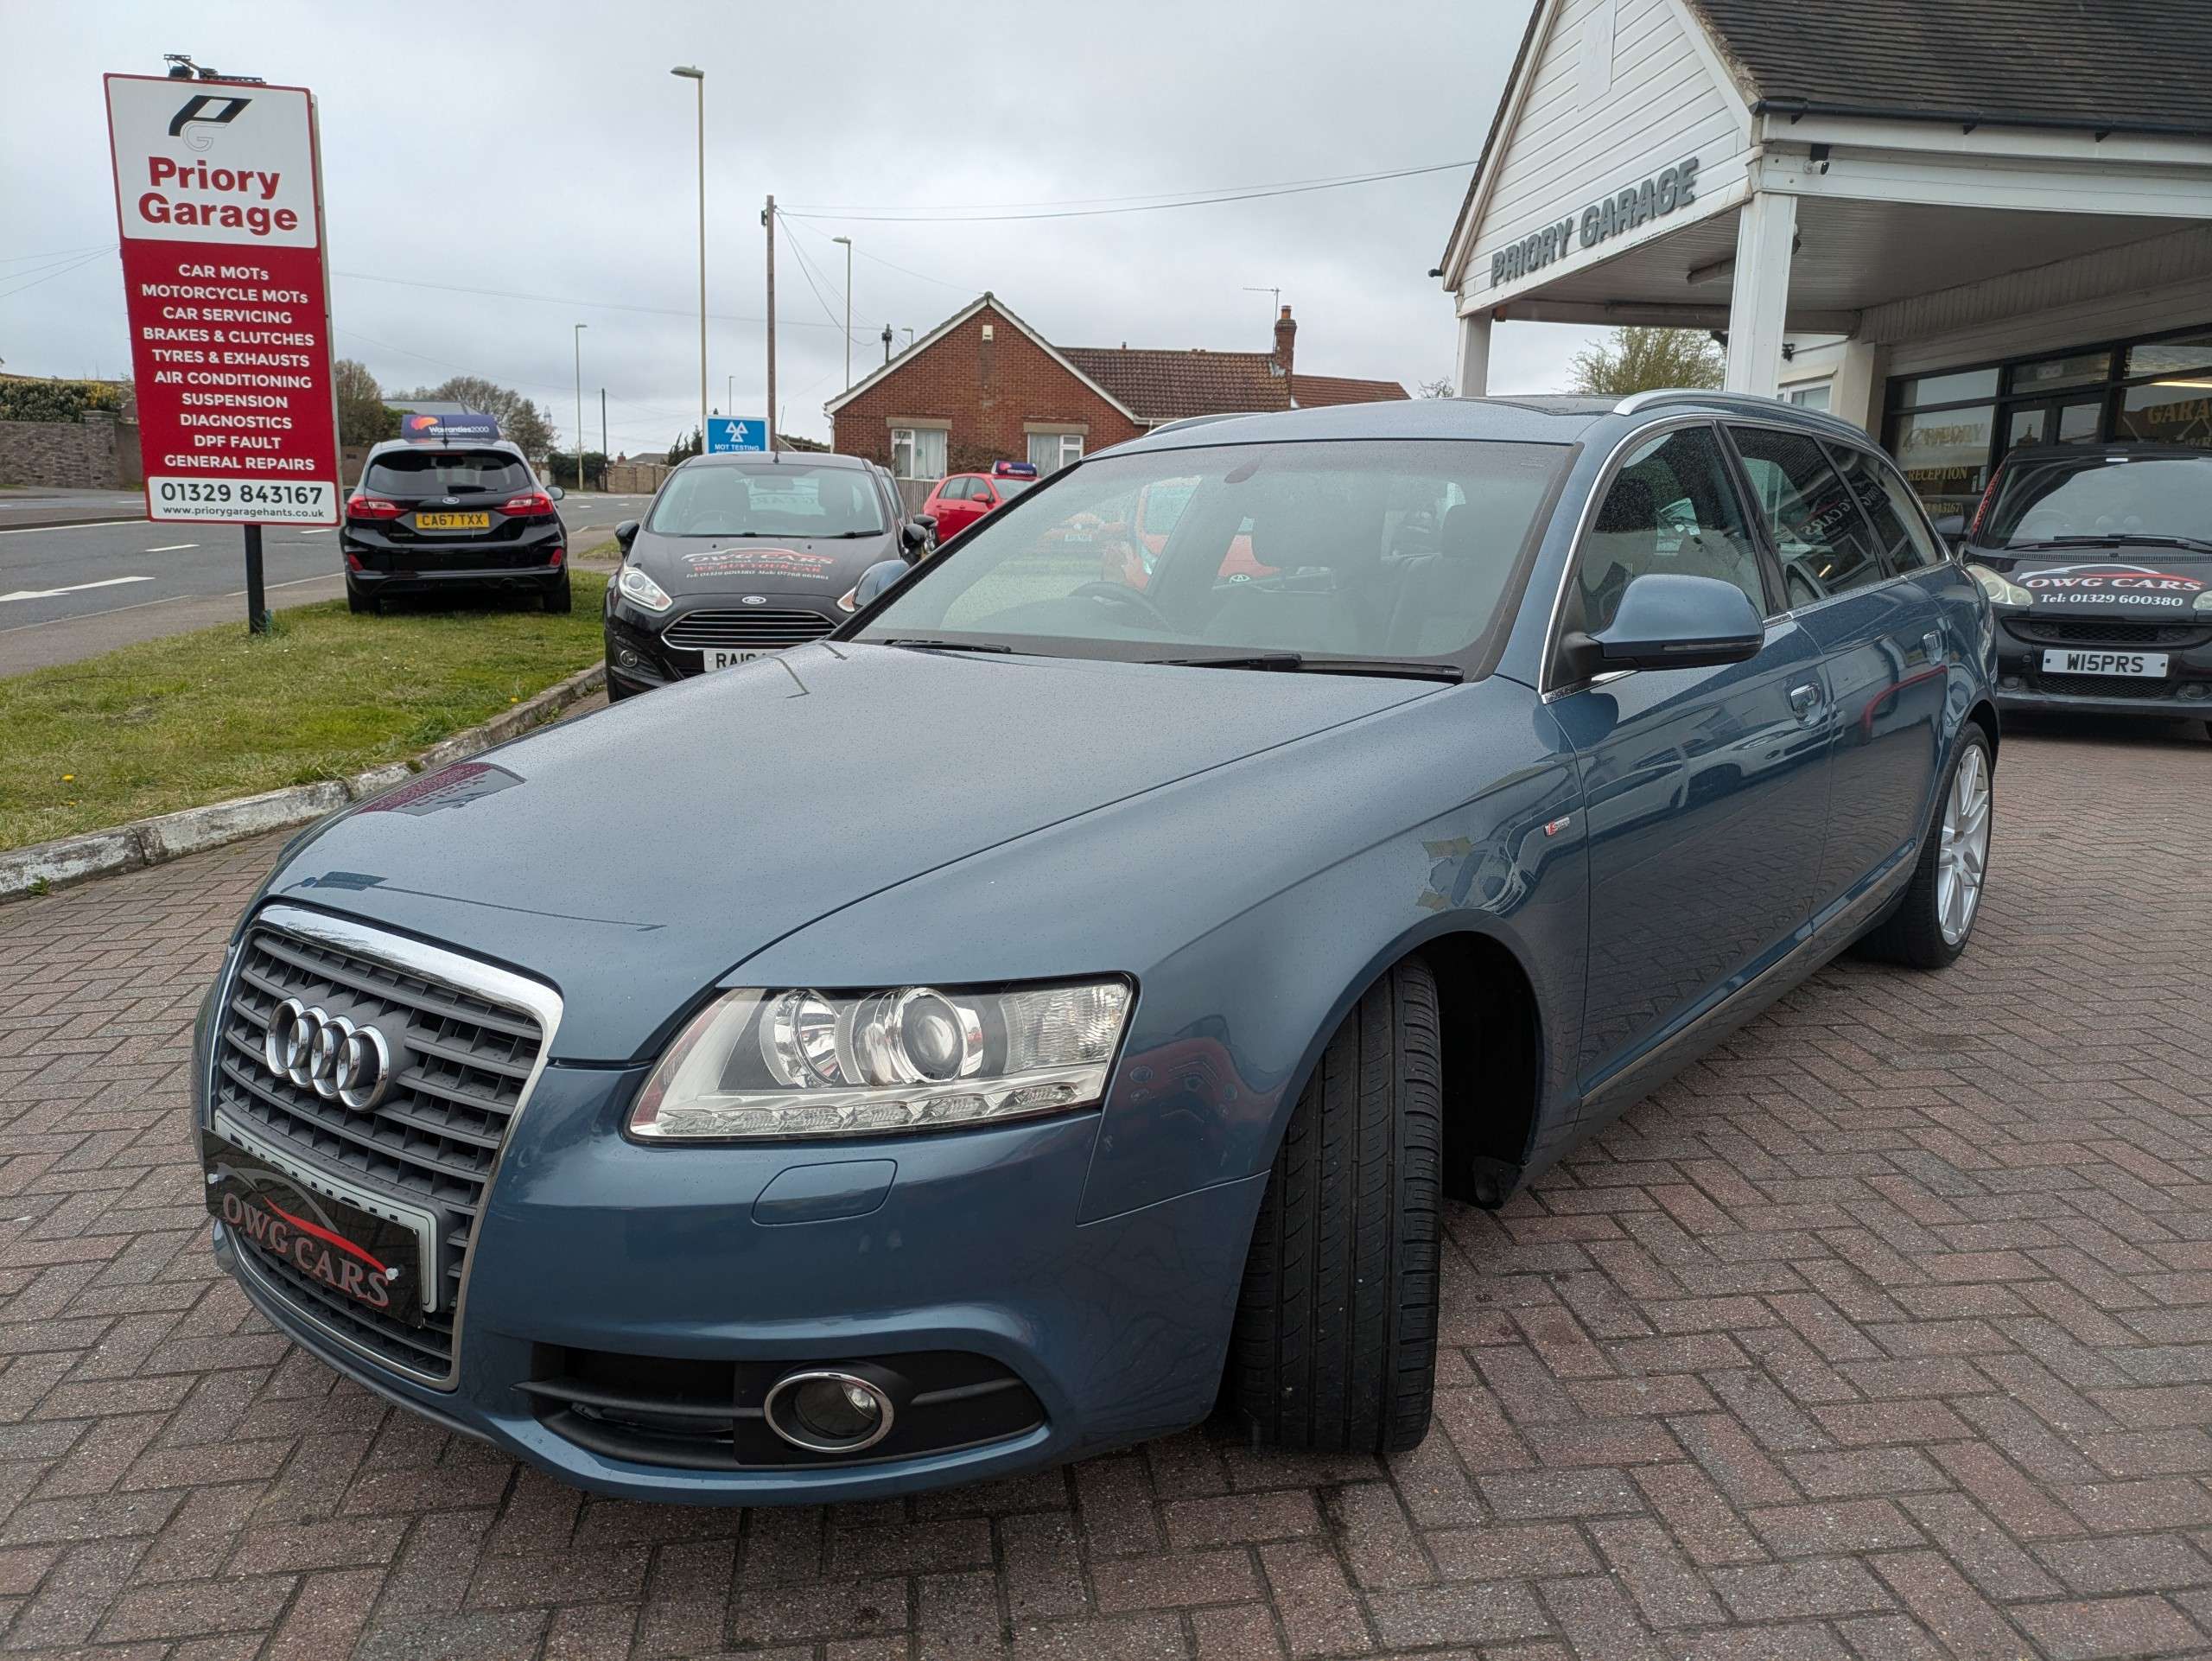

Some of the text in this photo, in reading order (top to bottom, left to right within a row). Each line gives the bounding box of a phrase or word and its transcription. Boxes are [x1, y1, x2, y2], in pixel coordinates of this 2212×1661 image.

[149, 156, 280, 200] Priory
[138, 193, 298, 236] Garage
[1491, 156, 1700, 288] PRIORY GARAGE
[179, 264, 269, 280] CAR MOTs
[143, 284, 308, 303] MOTORCYCLE MOTs
[163, 307, 292, 324] CAR SERVICING
[143, 328, 315, 346] BRAKES & CLUTCHES
[152, 349, 309, 367] TYRES & EXHAUSTS
[155, 372, 311, 388] AIR CONDITIONING
[182, 393, 288, 408] SUSPENSION
[2148, 399, 2211, 423] GARA
[180, 414, 292, 429] DIAGNOSTICS
[194, 435, 281, 449] DPF FAULT
[165, 455, 315, 470] GENERAL REPAIRS
[1908, 467, 1967, 481] RECEPTION
[161, 483, 322, 504] 01329 843167
[163, 506, 323, 518] www.priorygaragehants.co.uk
[423, 514, 483, 525] CA67 TXX
[2025, 577, 2201, 591] OWG CARS
[2041, 594, 2183, 607] Tel: 01329 600380
[222, 1193, 390, 1307] OWG CARS
